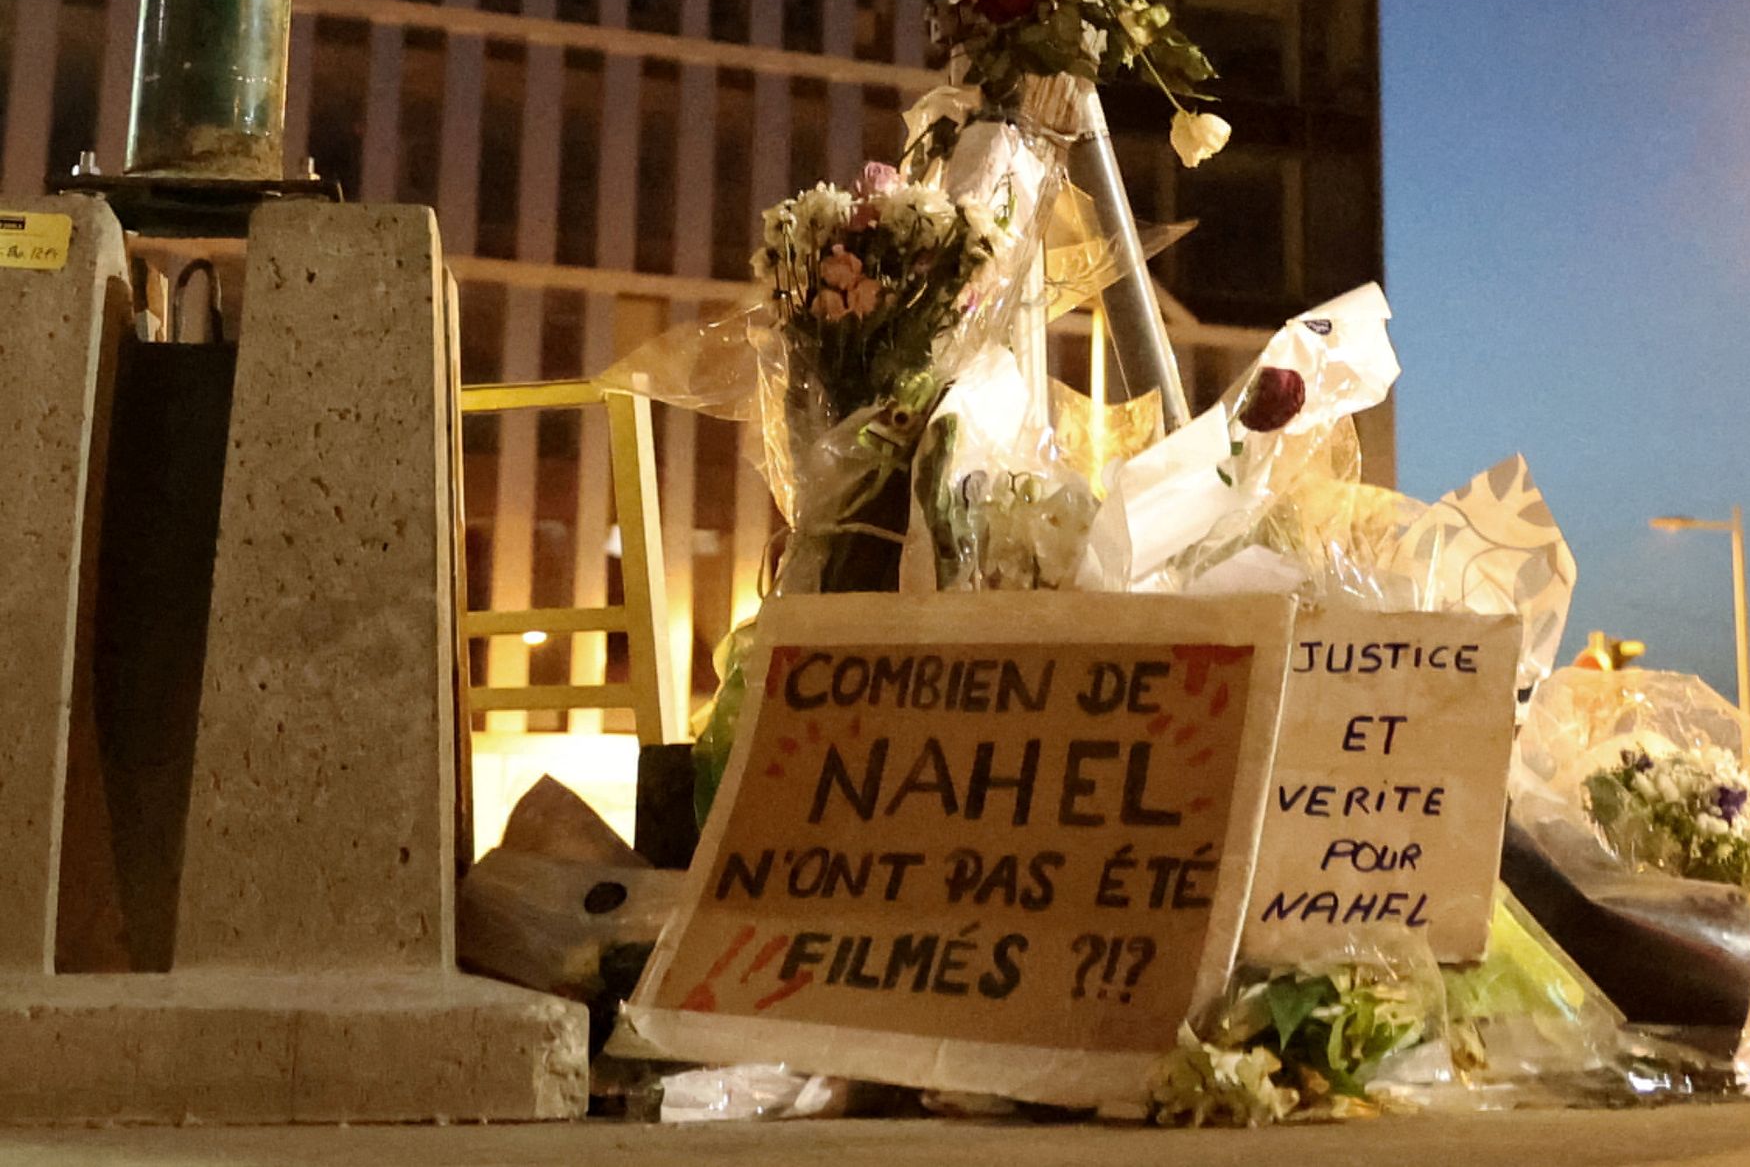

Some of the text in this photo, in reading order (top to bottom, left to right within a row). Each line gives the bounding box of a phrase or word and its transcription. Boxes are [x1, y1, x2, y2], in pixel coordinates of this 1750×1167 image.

[784, 653, 1170, 715] COMBIEN DE
[1341, 715, 1408, 755] ET
[807, 737, 1181, 828] NAHEL
[714, 844, 1220, 911] N'ONT PAS ÉTÉ
[1320, 839, 1422, 872] POUR
[778, 923, 1158, 1004] FILMÉS ?!?
